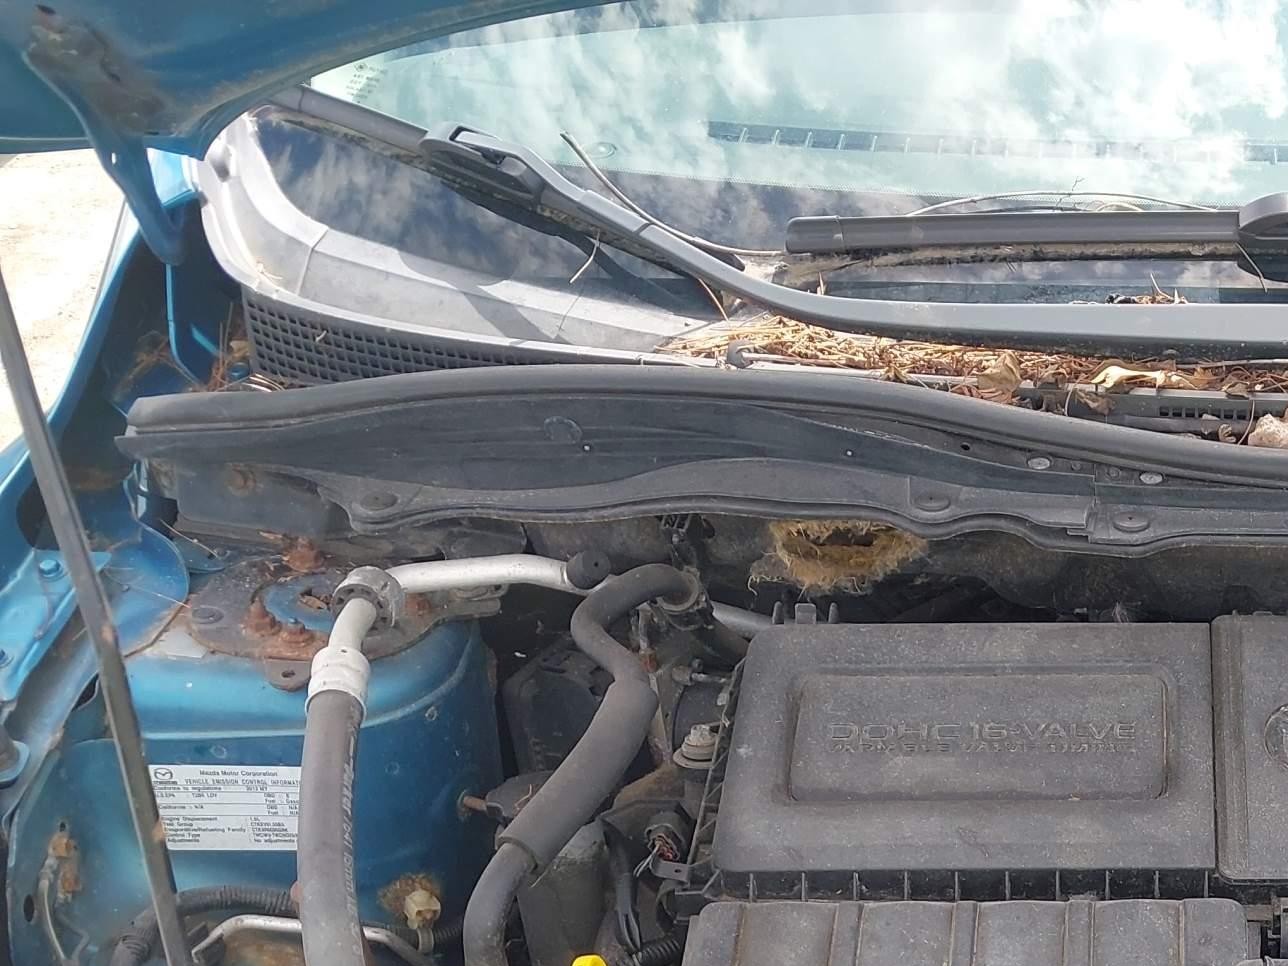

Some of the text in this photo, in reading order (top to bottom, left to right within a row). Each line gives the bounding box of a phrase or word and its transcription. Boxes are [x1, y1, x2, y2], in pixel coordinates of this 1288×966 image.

[831, 719, 1137, 741] DOHC 16-VALVE
[199, 769, 278, 778] Mazda Motor Corporation
